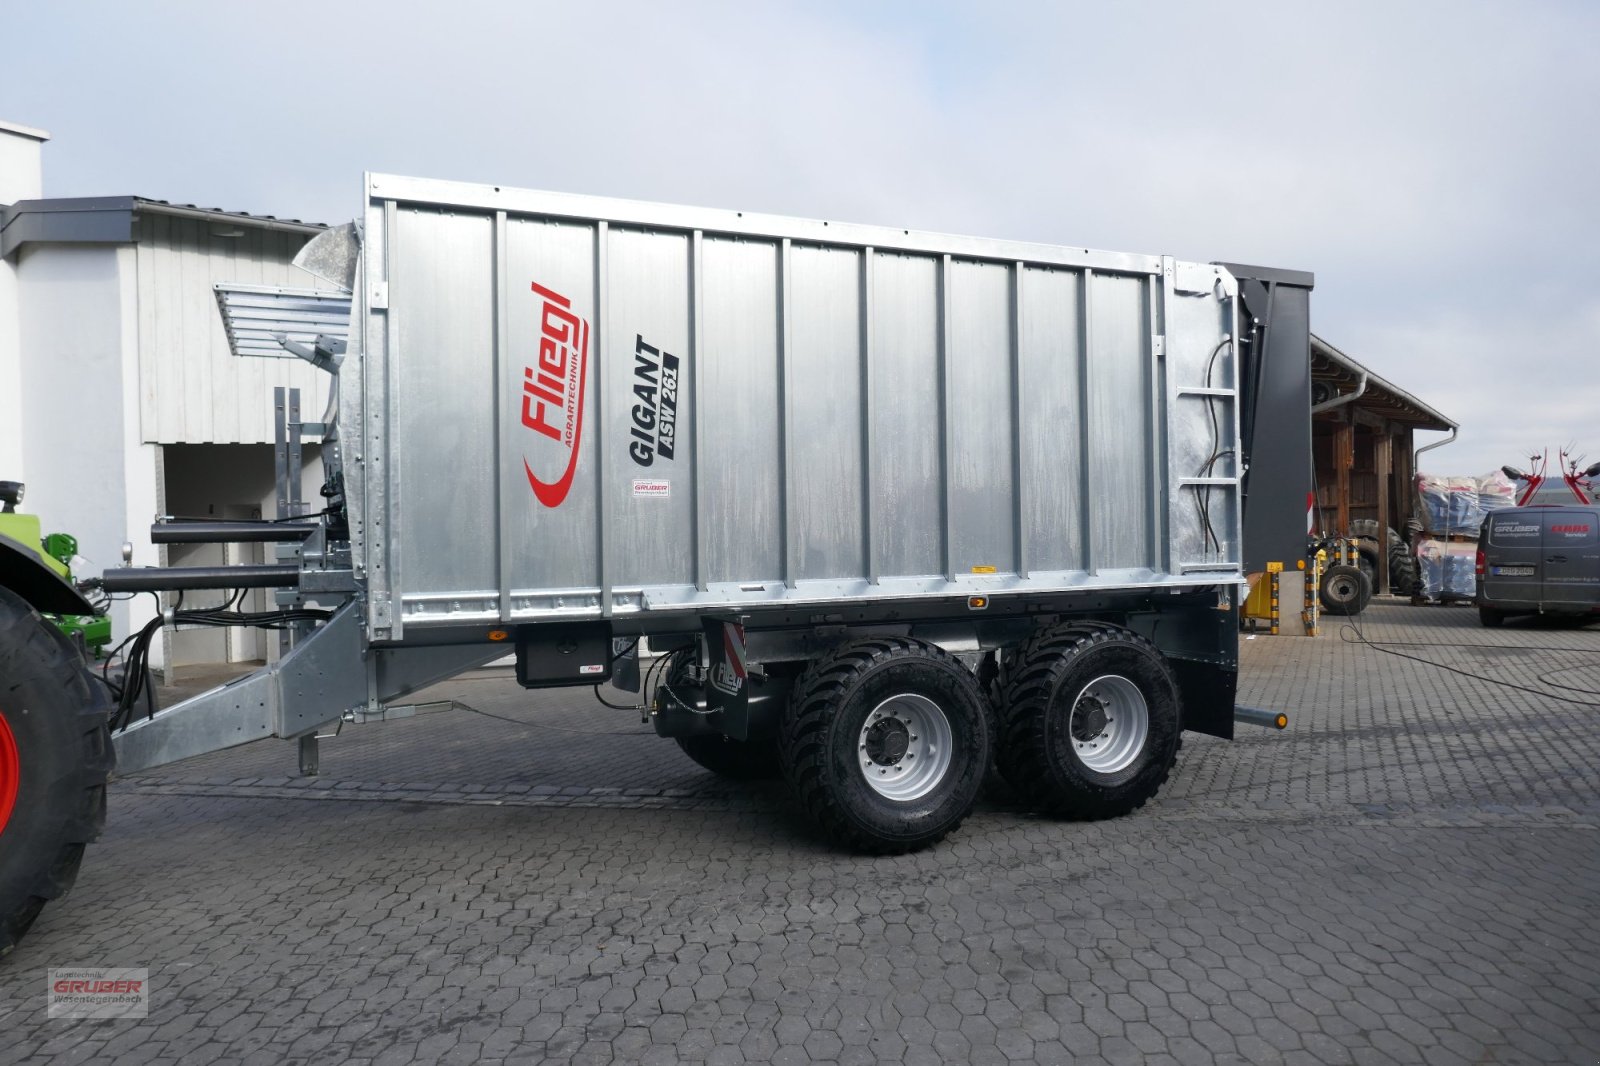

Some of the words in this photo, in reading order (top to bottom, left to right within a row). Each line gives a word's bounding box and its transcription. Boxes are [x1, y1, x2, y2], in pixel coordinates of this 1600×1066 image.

[521, 281, 580, 441] Fliegl
[565, 352, 578, 448] AGRARTECHNIK
[629, 333, 660, 467] GIGANT
[662, 368, 678, 399] 261
[659, 402, 675, 449] ASW
